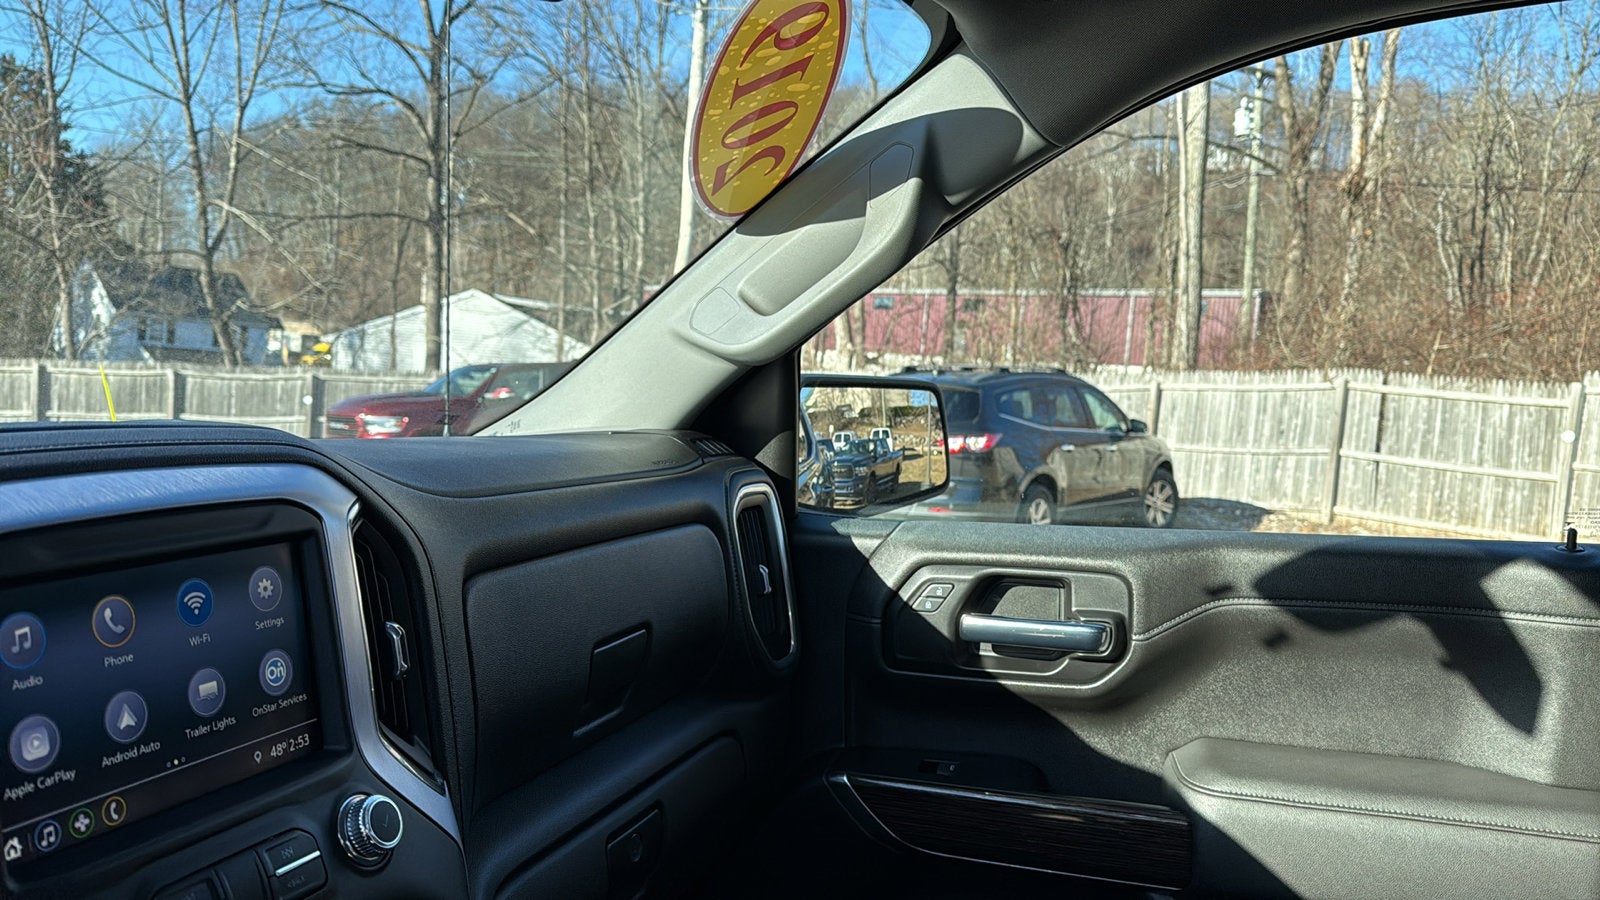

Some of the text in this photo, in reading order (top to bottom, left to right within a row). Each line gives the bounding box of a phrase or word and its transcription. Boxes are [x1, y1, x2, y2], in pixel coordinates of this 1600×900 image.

[255, 616, 284, 630] Settings
[189, 634, 211, 646] Wi-Fi
[104, 653, 134, 667] Phone
[13, 675, 43, 690] Audio
[252, 693, 307, 717] OnStar Services
[185, 716, 236, 740] Trailer Lights
[289, 733, 310, 752] 2:53
[102, 741, 161, 767] Android Auto
[4, 769, 76, 801] Apple CarPlay
